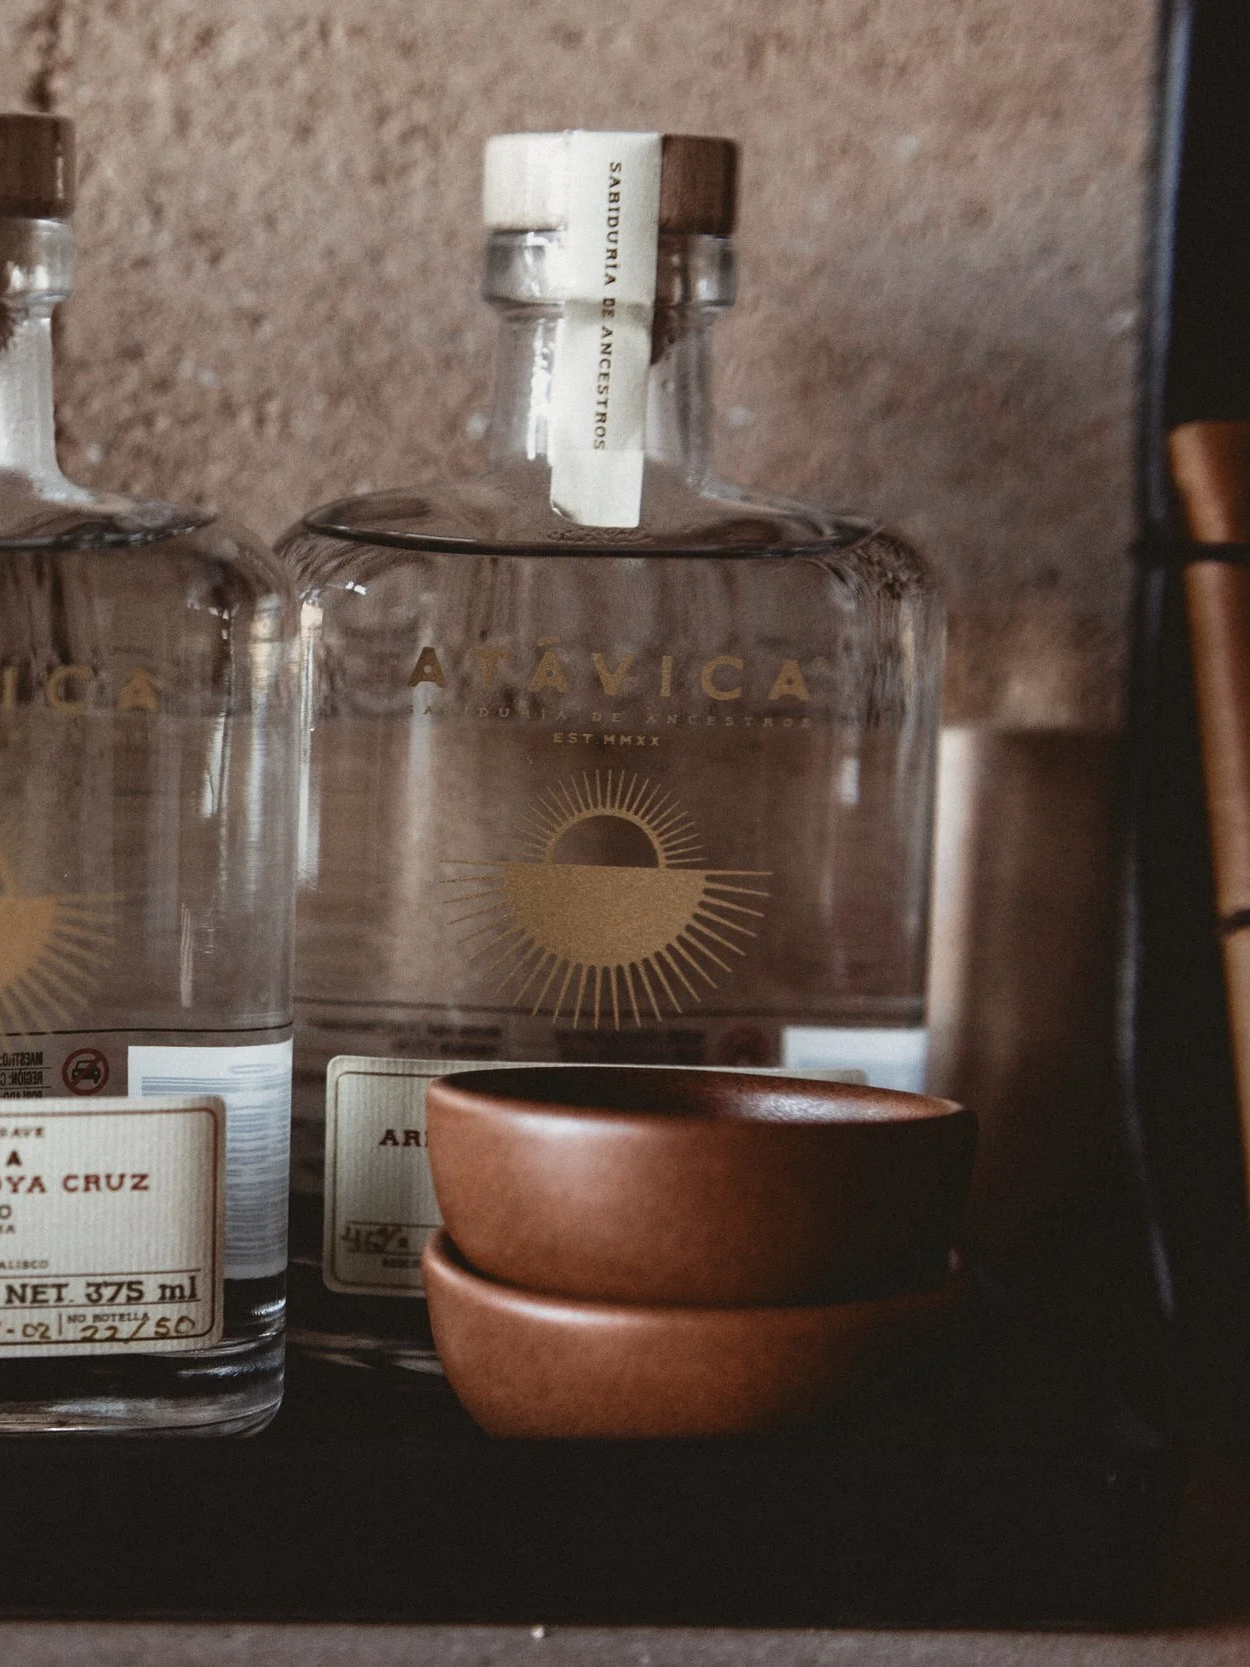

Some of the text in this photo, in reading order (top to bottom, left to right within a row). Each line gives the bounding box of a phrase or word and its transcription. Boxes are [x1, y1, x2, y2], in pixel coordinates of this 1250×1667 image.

[603, 297, 617, 317] DE
[593, 326, 614, 451] ANCESTROS
[406, 636, 812, 702] ATÁVICA
[62, 1173, 151, 1194] CRUZ
[84, 1280, 145, 1303] 375
[157, 1275, 200, 1301] ml
[91, 1312, 151, 1324] BOTELLA
